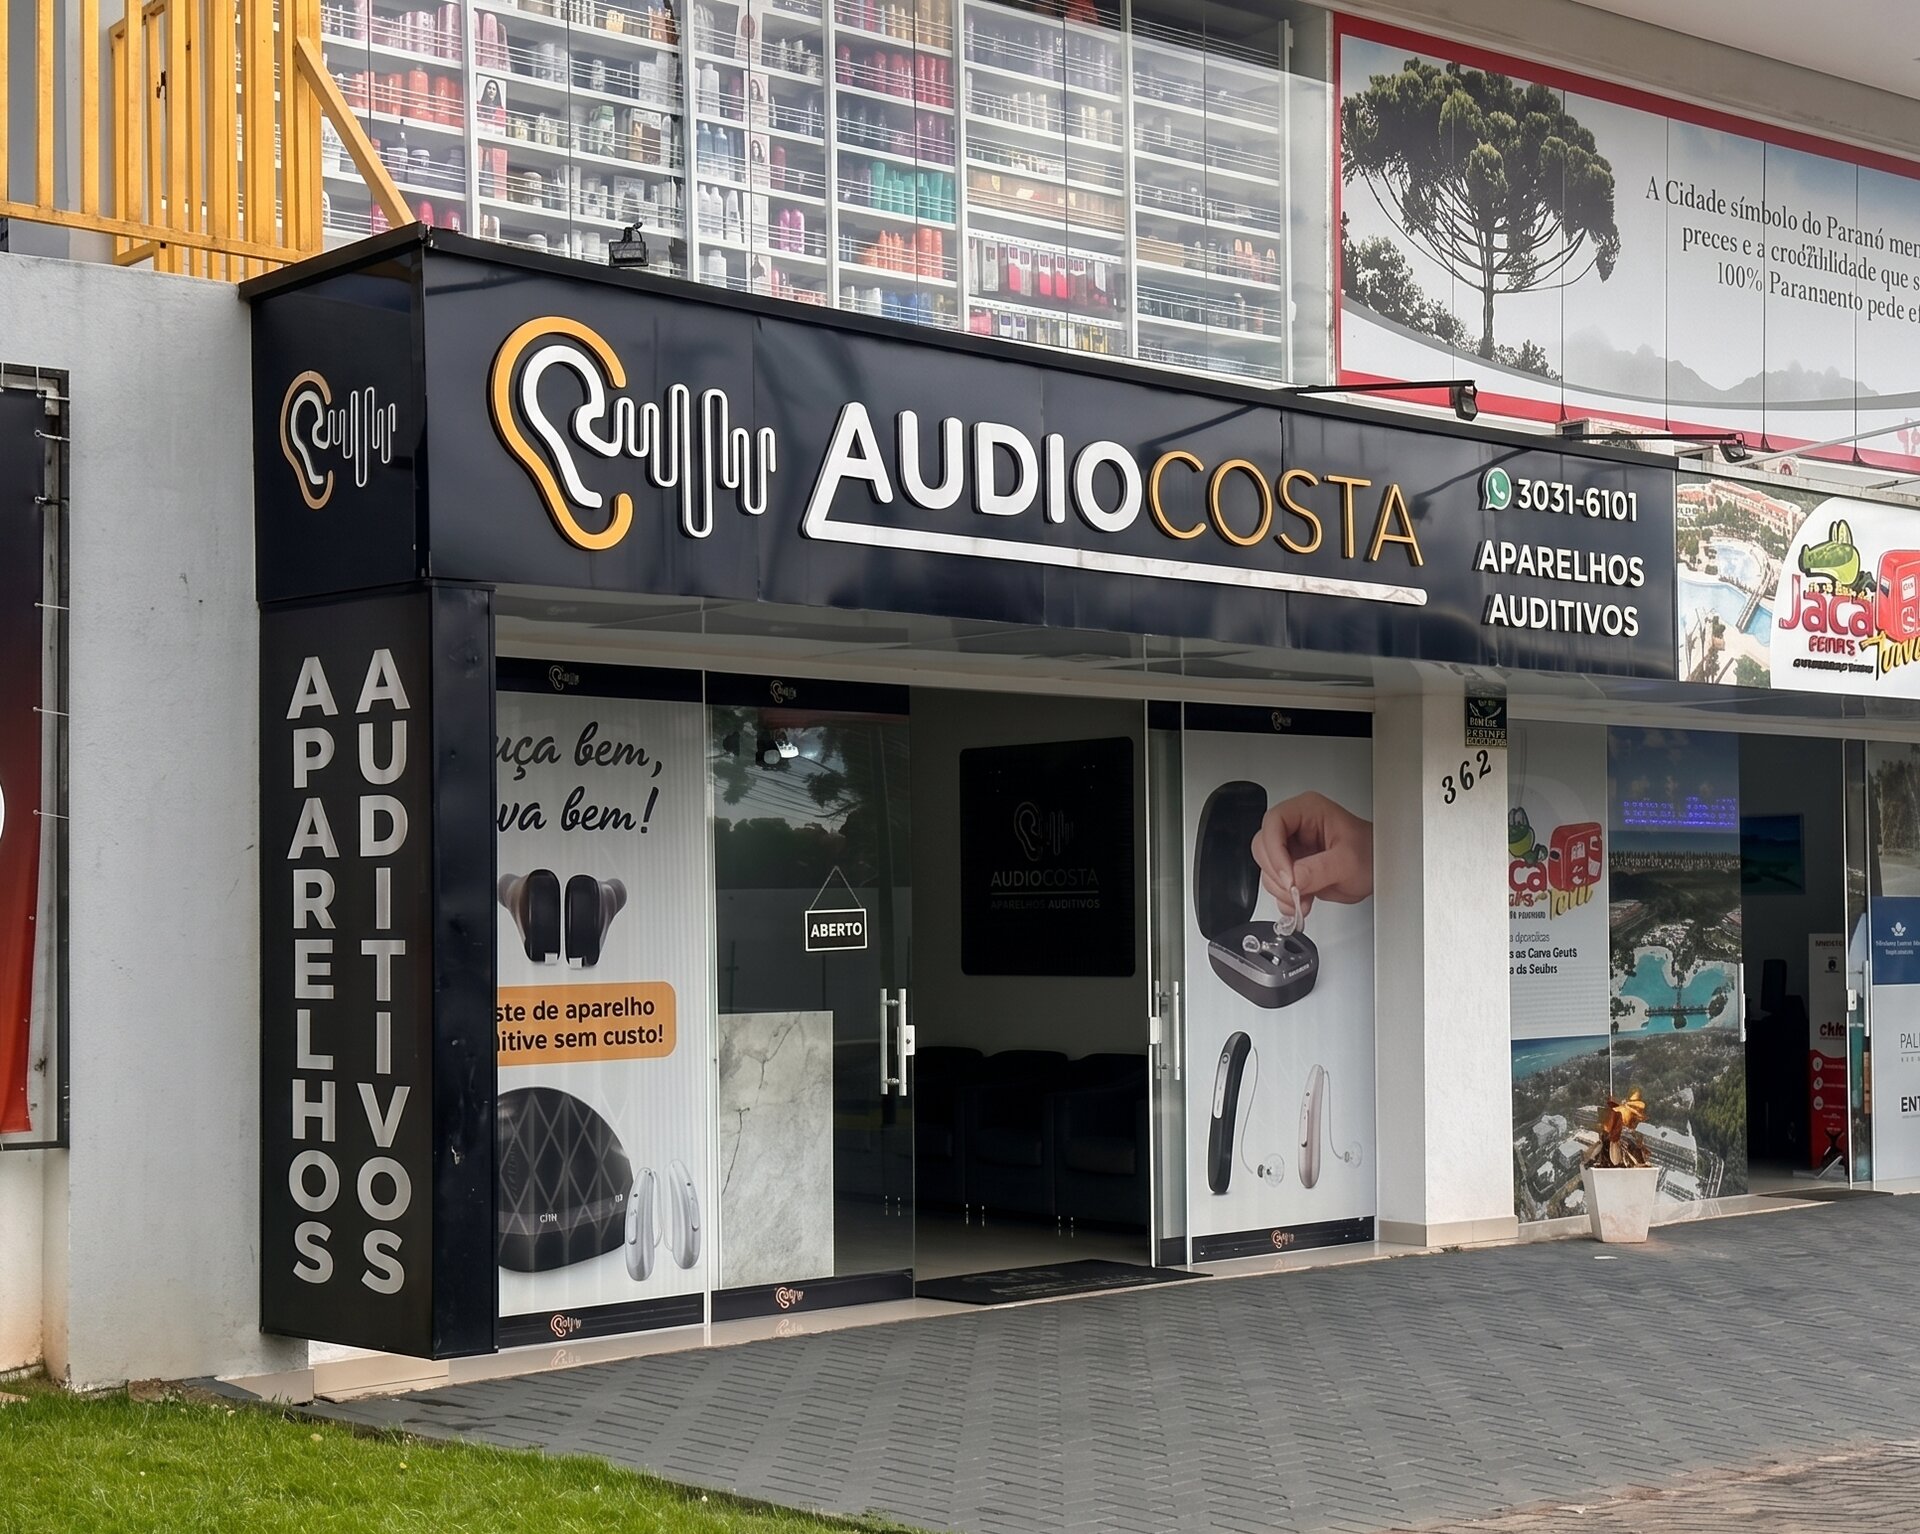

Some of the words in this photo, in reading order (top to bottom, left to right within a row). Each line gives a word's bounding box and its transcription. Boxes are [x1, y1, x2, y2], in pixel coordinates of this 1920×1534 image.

[1646, 176, 1660, 201] A
[1666, 180, 1726, 215] Cidade
[1730, 196, 1798, 231] símbolo
[1802, 211, 1822, 236] do
[1682, 227, 1737, 252] preces
[1742, 239, 1752, 255] e
[1757, 242, 1765, 258] a
[1881, 269, 1909, 292] que
[1717, 262, 1763, 292] 100%
[1867, 296, 1905, 321] pede
[803, 401, 1425, 568] AUDIOCOSTA
[1517, 478, 1637, 521] 3031-6101
[1477, 540, 1645, 587] APARELHOS
[1487, 593, 1639, 637] AUDITIVOS
[574, 721, 663, 778] bem,
[1442, 750, 1491, 804] 362
[561, 786, 659, 834] bem!
[990, 868, 1100, 888] AUDIOCOSTA
[1048, 899, 1101, 909] AUDITIVOS
[810, 921, 863, 938] ABERTO
[286, 656, 340, 1284] APARELHOS
[355, 648, 412, 1295] AUDITIVOS
[532, 1000, 559, 1021] de
[565, 996, 655, 1023] aparelho
[497, 1030, 547, 1051] itive
[554, 1031, 597, 1049] sem
[603, 1024, 663, 1046] custo!
